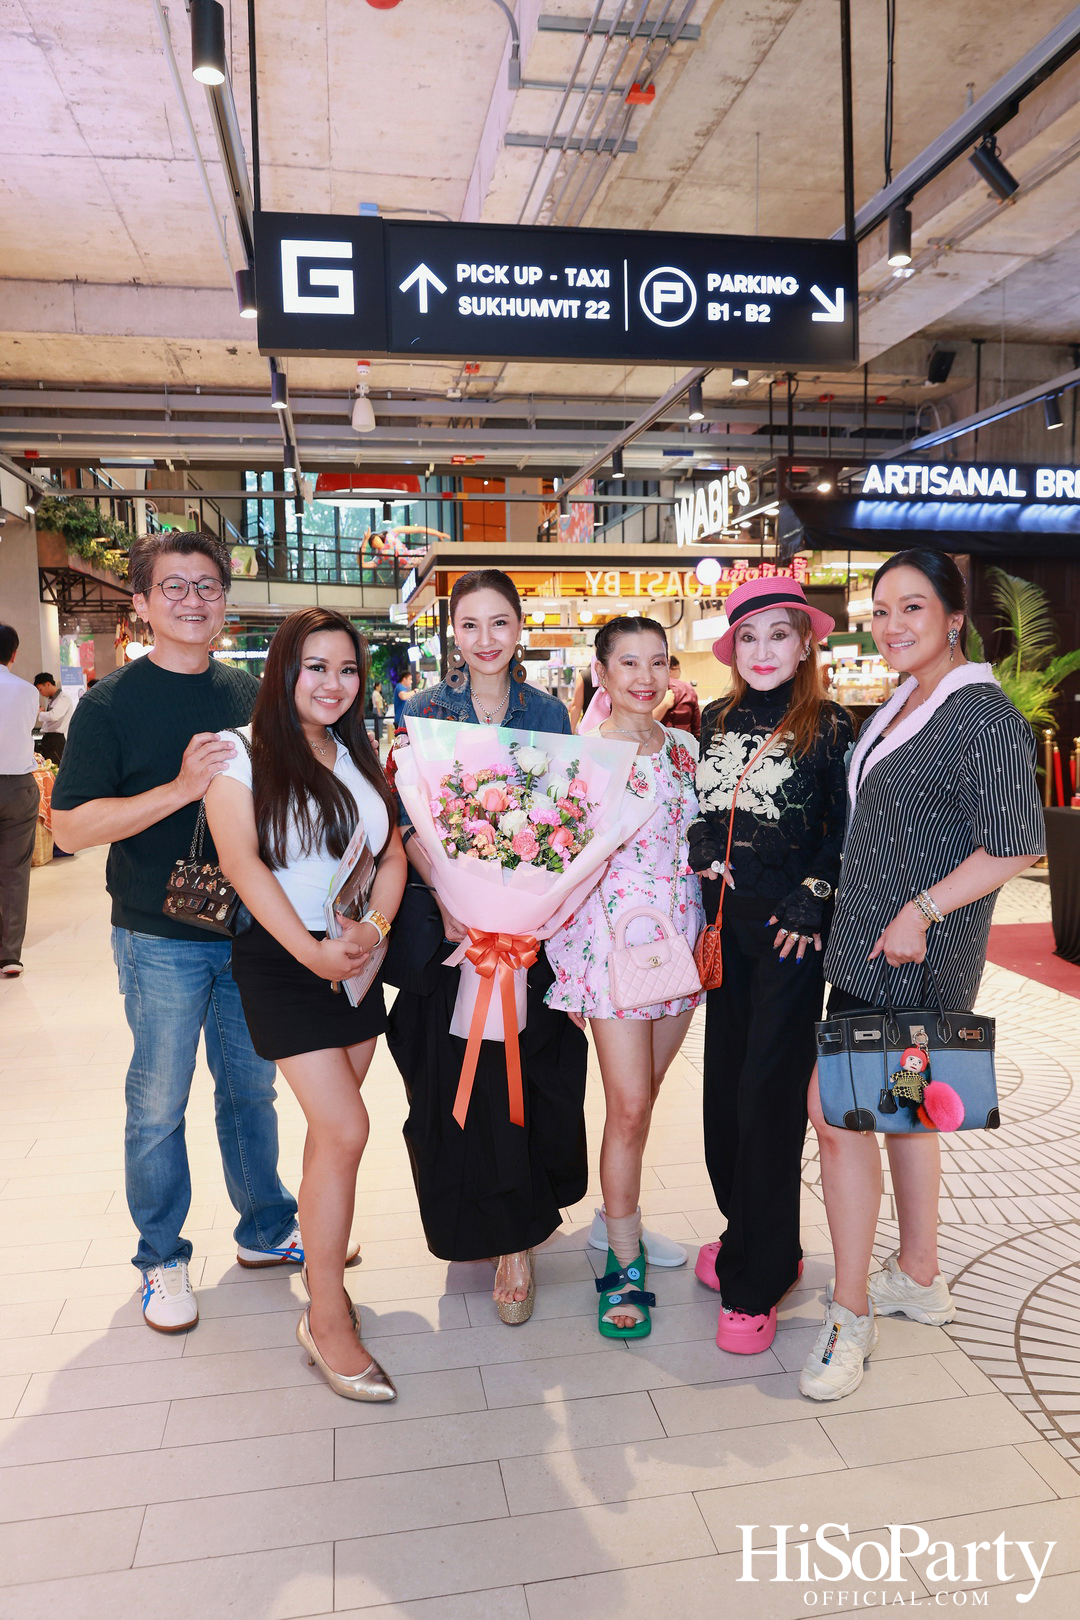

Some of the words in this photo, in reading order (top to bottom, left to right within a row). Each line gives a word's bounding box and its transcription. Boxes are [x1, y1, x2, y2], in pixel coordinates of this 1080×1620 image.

[280, 239, 355, 315] G
[456, 263, 510, 285] PICK
[513, 265, 543, 285] UP
[564, 267, 610, 288] TAXI
[707, 273, 800, 296] PARKING
[458, 295, 581, 319] SUKHUMVIT
[584, 300, 611, 320] 22
[862, 464, 1027, 498] ARTISANAL
[674, 464, 751, 549] WABI'S
